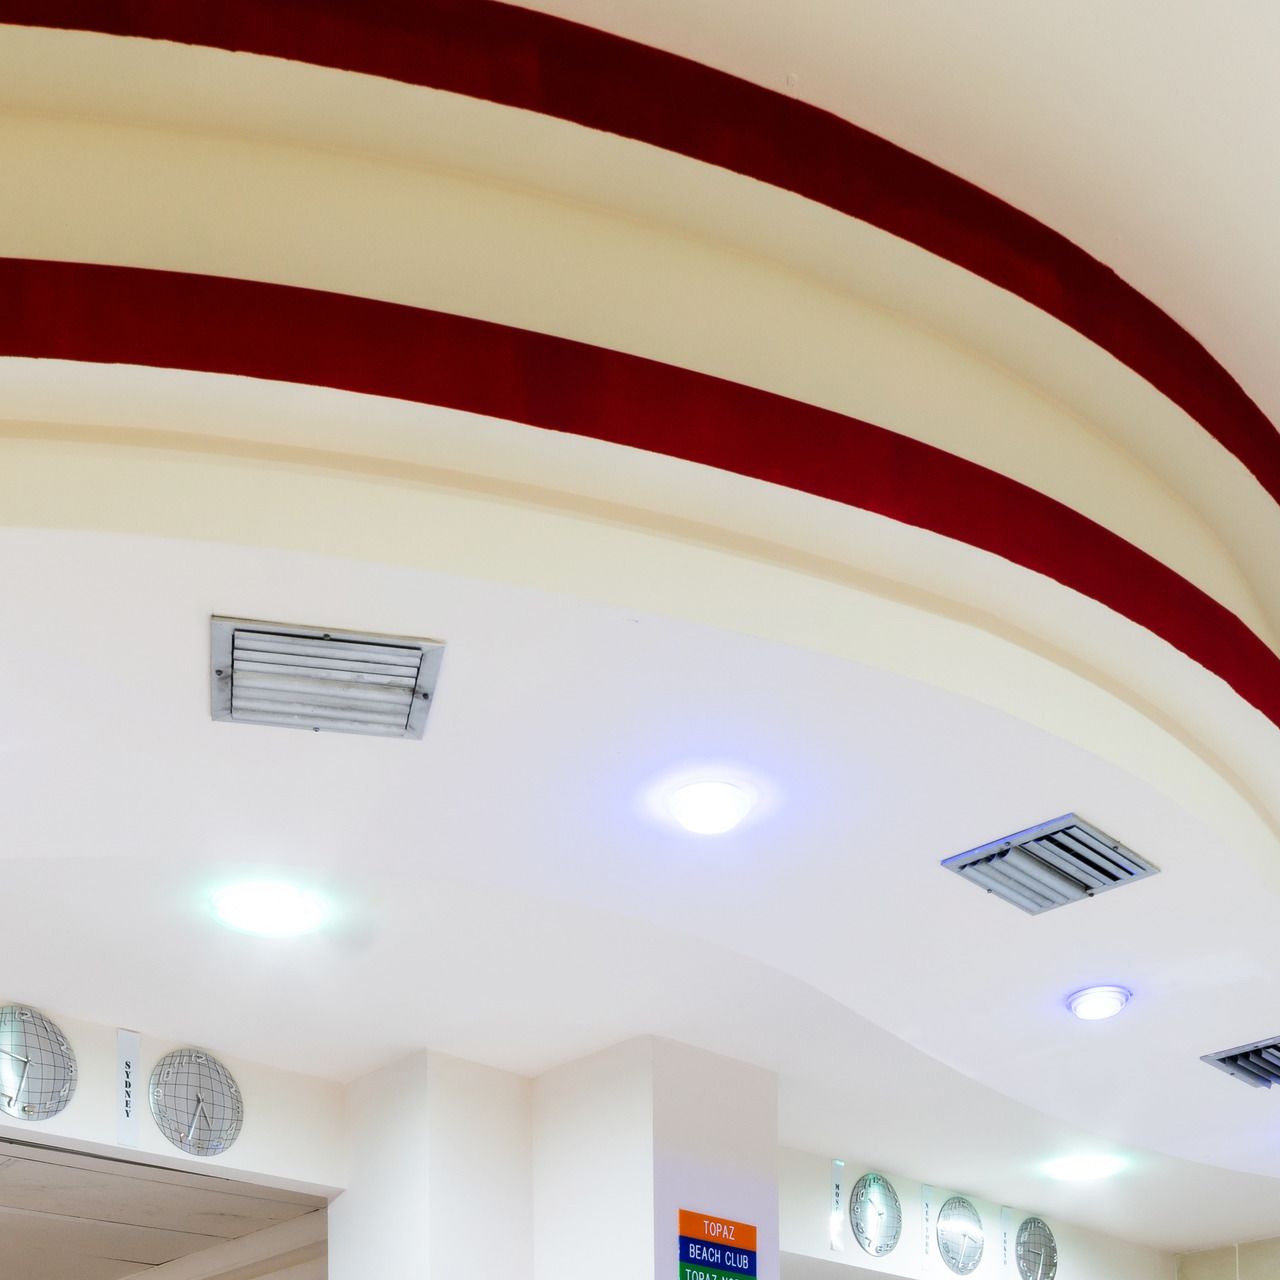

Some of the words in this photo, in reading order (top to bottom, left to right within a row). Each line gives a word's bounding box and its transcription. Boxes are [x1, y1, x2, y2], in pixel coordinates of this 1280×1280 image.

[124, 1061, 132, 1118] SYDNEY
[704, 1220, 736, 1240] TOPAZ
[689, 1243, 721, 1263] BEACH
[725, 1252, 749, 1269] CLUB
